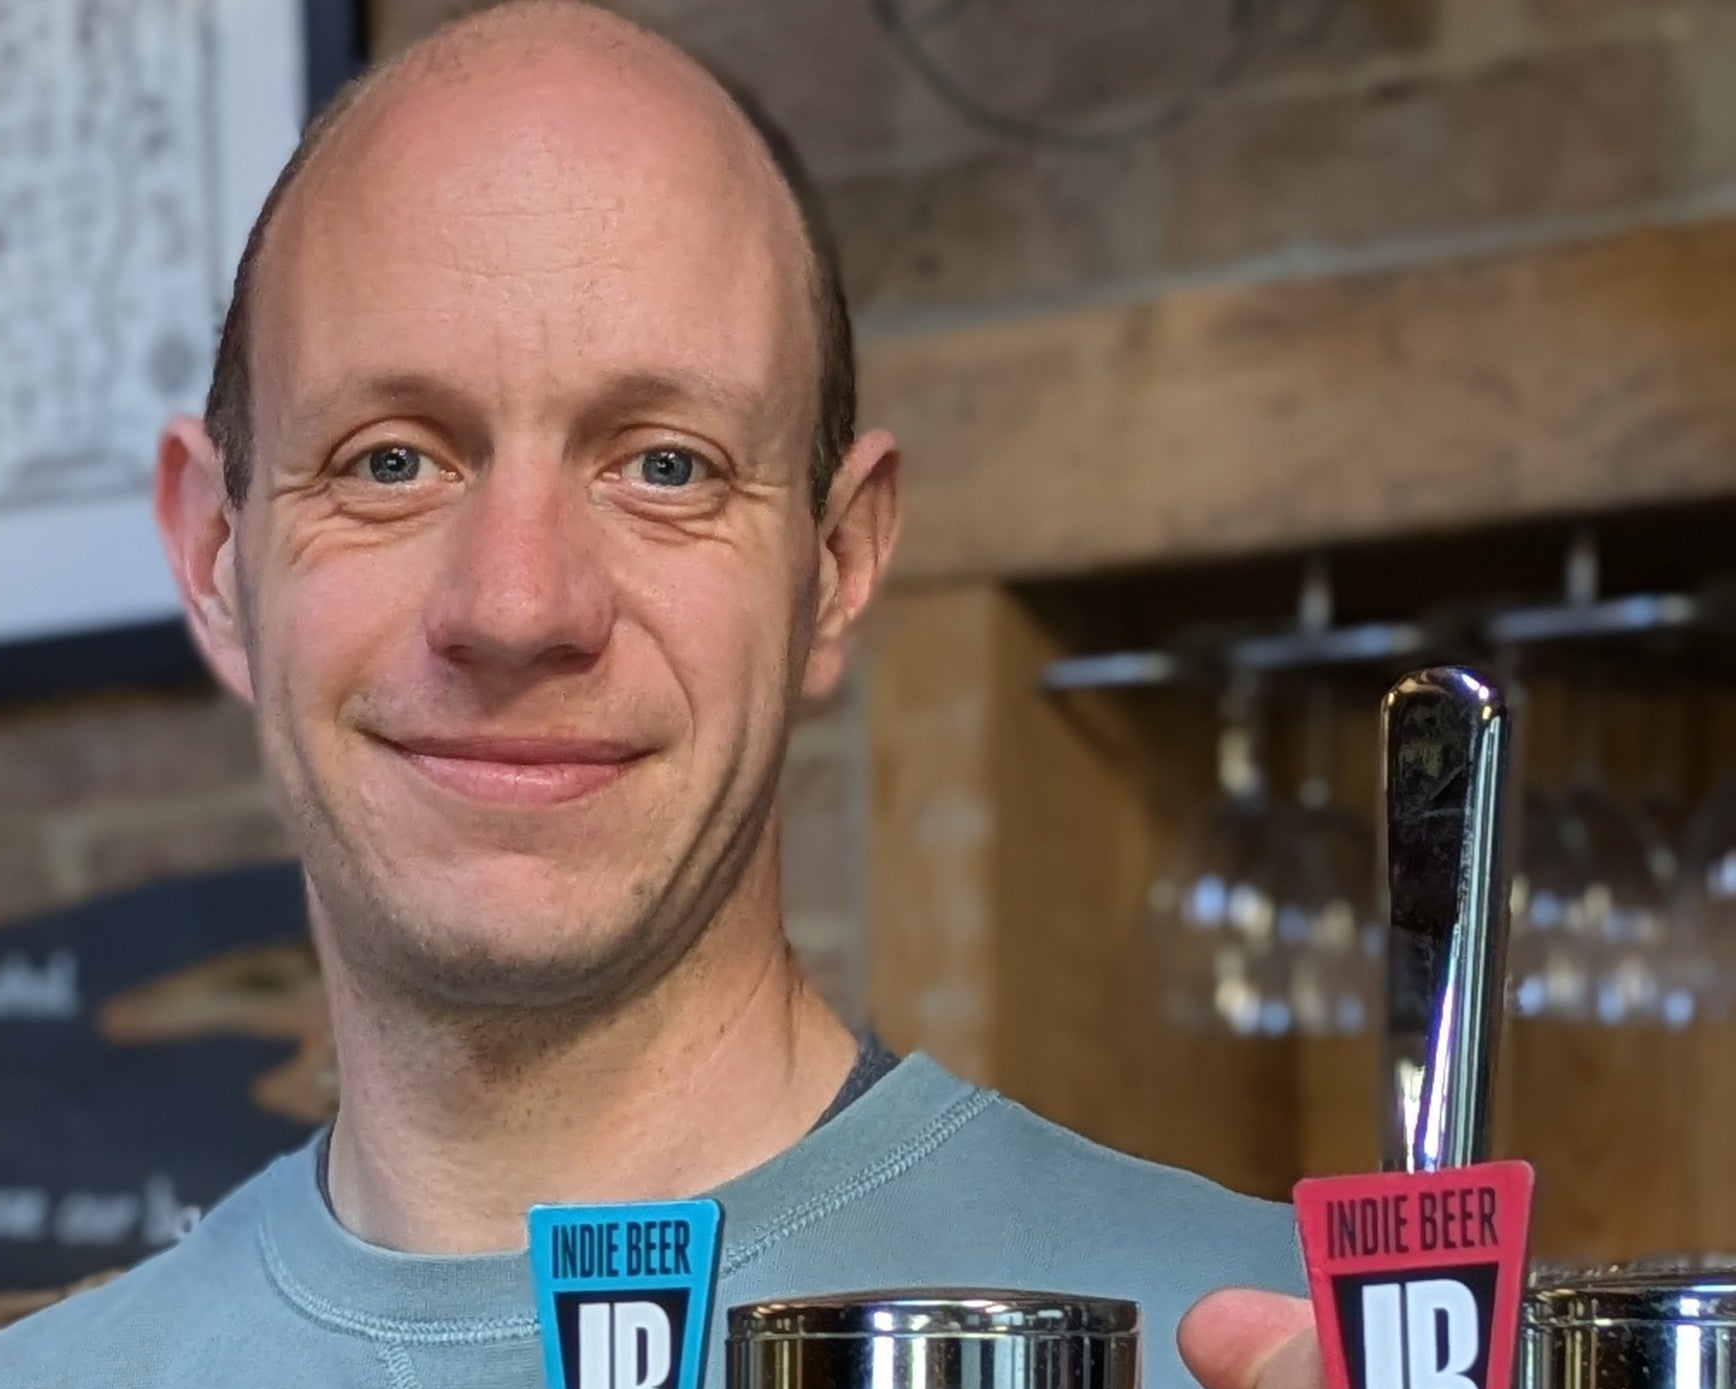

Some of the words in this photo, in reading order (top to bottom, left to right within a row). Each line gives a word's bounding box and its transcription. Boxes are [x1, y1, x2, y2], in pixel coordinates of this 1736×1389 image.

[551, 1222, 619, 1279] INDIE
[625, 1219, 692, 1277] BEER
[1326, 1193, 1409, 1260] INDIE
[1418, 1187, 1500, 1252] BEER
